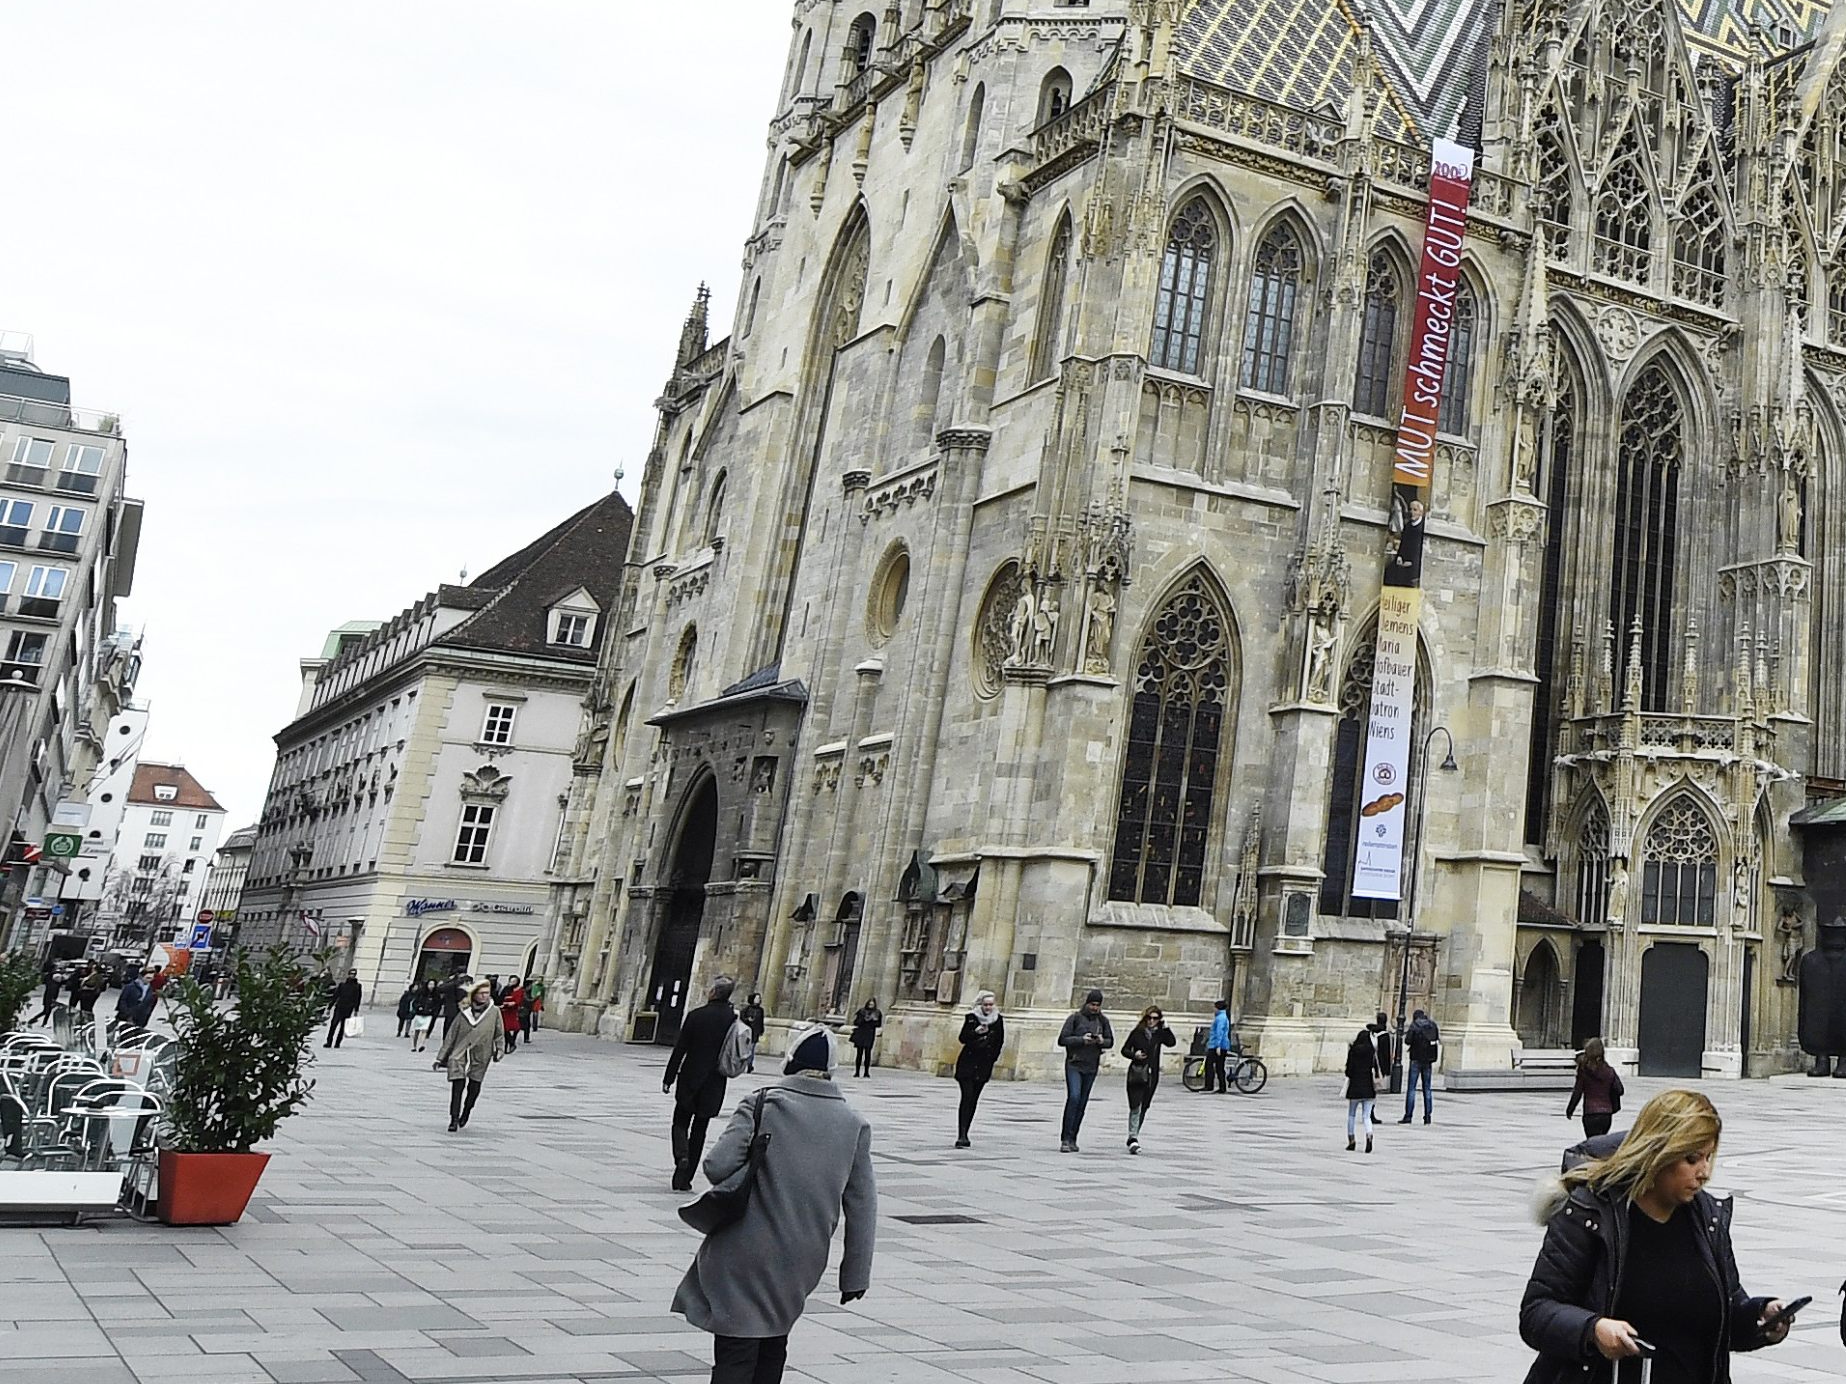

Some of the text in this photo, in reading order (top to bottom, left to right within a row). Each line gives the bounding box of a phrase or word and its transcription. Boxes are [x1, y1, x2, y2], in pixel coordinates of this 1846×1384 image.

[1395, 199, 1466, 478] MUT schmeckt GUT!
[1382, 595, 1411, 618] eiliger
[1380, 614, 1413, 636] lemens
